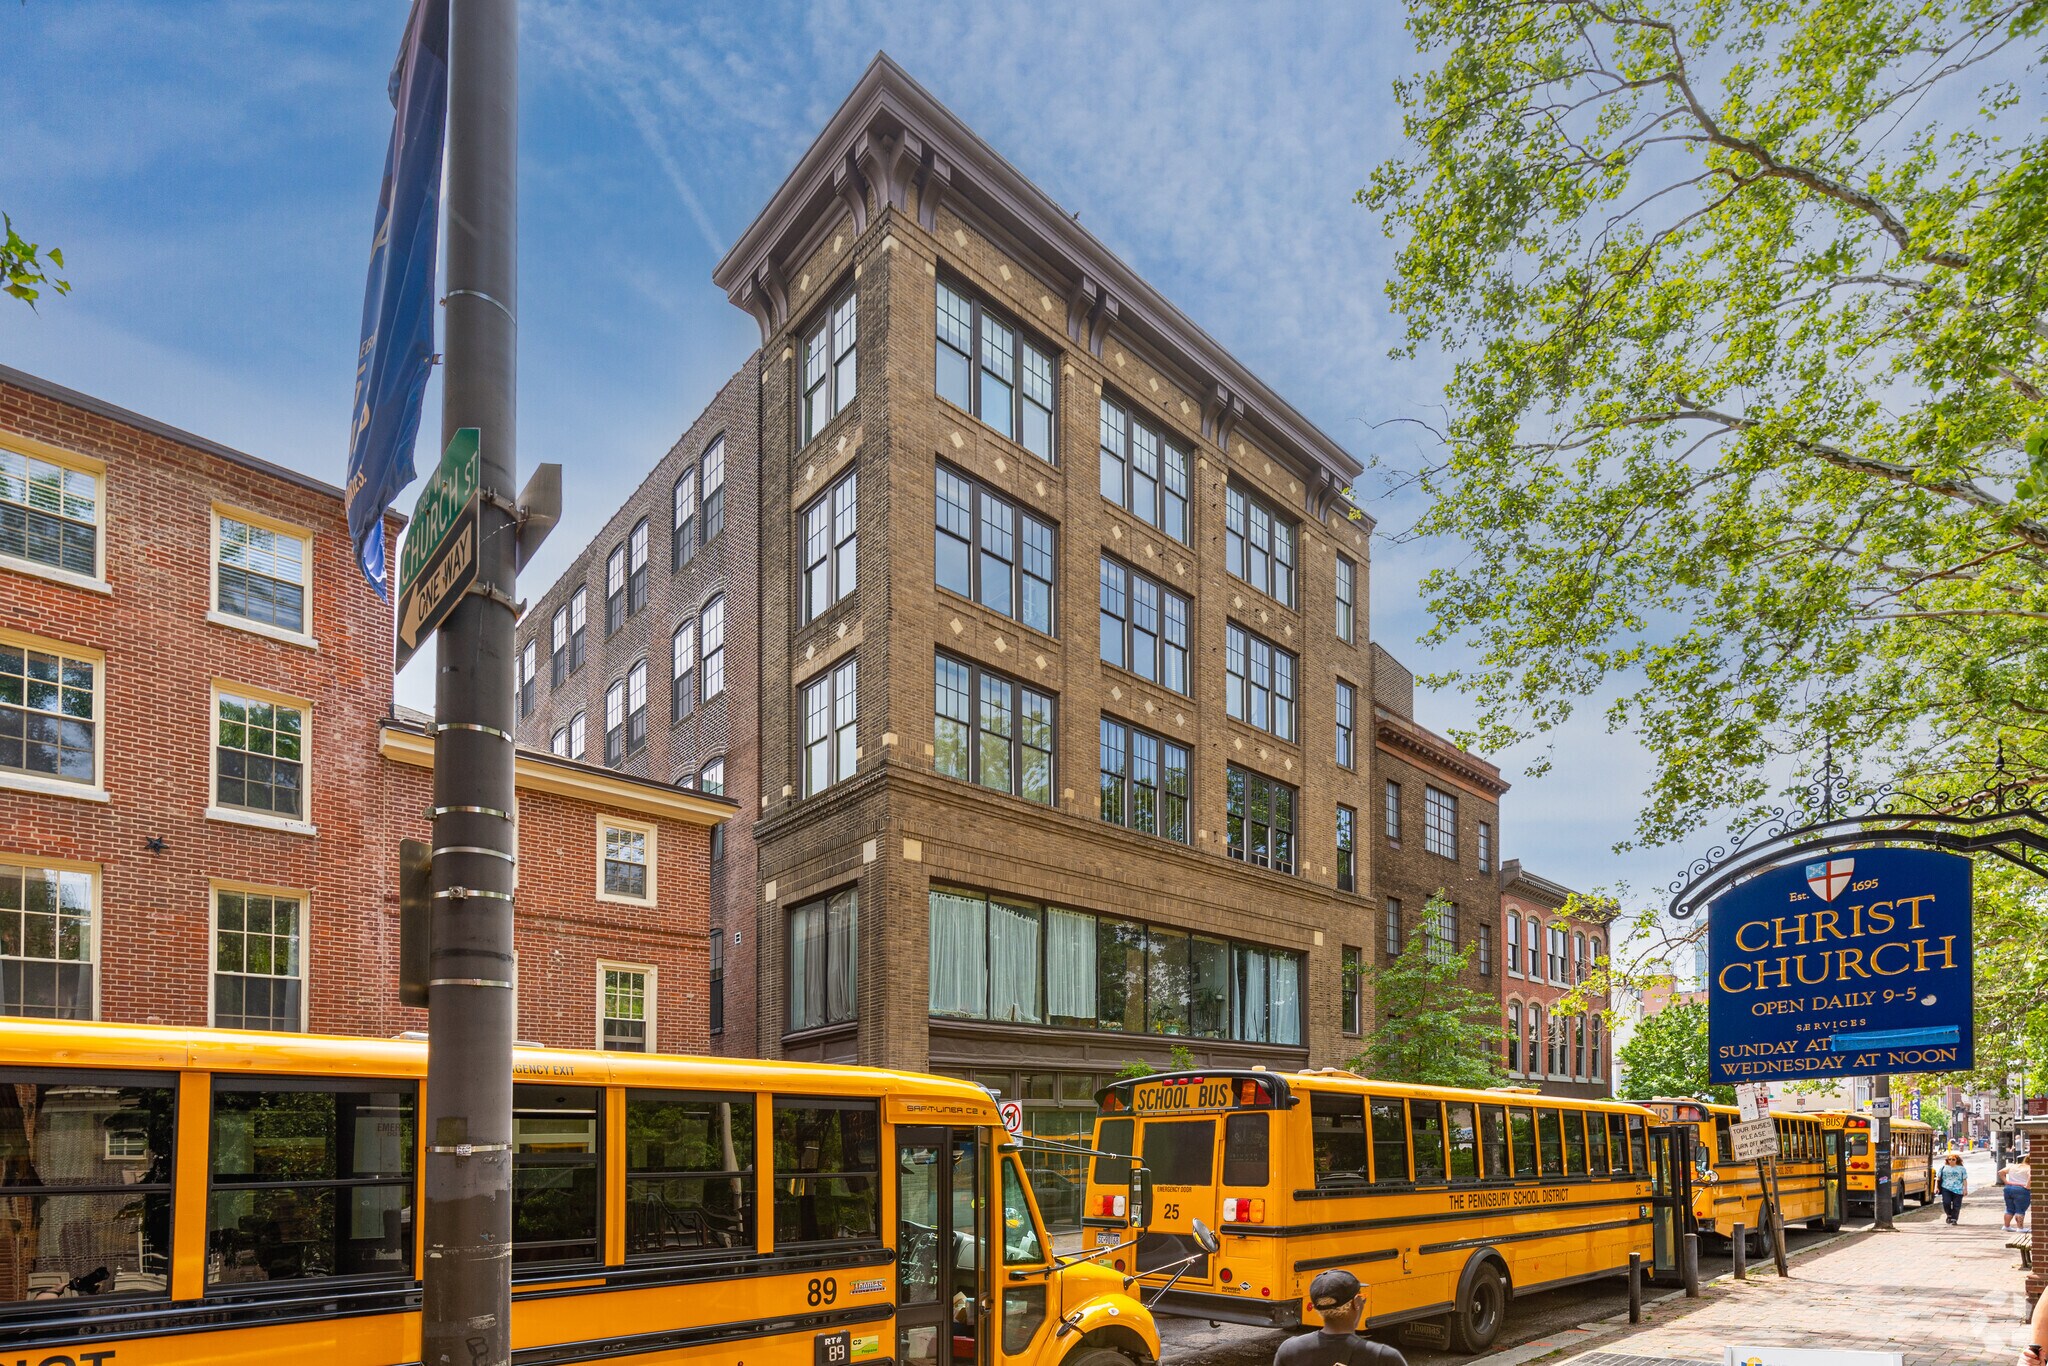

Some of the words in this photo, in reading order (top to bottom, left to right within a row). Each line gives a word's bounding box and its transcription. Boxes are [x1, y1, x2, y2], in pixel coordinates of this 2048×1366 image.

[402, 467, 458, 587] CHURCH
[464, 450, 478, 496] ST
[417, 569, 440, 622] ONE
[443, 533, 469, 587] WAY
[1789, 892, 1810, 902] Est.
[1852, 878, 1879, 892] 1695
[1735, 894, 1936, 952] CHRIST
[1718, 935, 1958, 993] CHURCH
[1751, 998, 1805, 1016] OPEN
[1812, 991, 1876, 1011] DAILY
[1882, 986, 1917, 1004] 9-5
[1796, 1018, 1867, 1032] SERVICES
[1719, 1040, 1799, 1059] SUNDAY
[1805, 1037, 1831, 1052] AT
[553, 1065, 575, 1076] EXIT
[1720, 1055, 1846, 1076] WEDNESDAY
[1852, 1052, 1881, 1068] AT
[1888, 1048, 1958, 1067] NOON
[1137, 1087, 1190, 1111] SCHOOL
[1198, 1084, 1228, 1107] BUS
[966, 1107, 978, 1115] C2
[1911, 1099, 1919, 1120] PARK
[1733, 1126, 1749, 1135] TOUR
[1750, 1121, 1772, 1131] BUSES
[1740, 1130, 1767, 1141] PLEASE
[1449, 1195, 1464, 1210] THE
[1468, 1192, 1511, 1209] PENNSBURY
[1513, 1190, 1540, 1205] SCHOOL
[1542, 1188, 1569, 1203] DISTRICT
[1164, 1203, 1180, 1220] 25
[807, 1277, 837, 1307] 89
[824, 1336, 842, 1346] RT#
[852, 1338, 862, 1346] C2
[829, 1344, 845, 1362] 89
